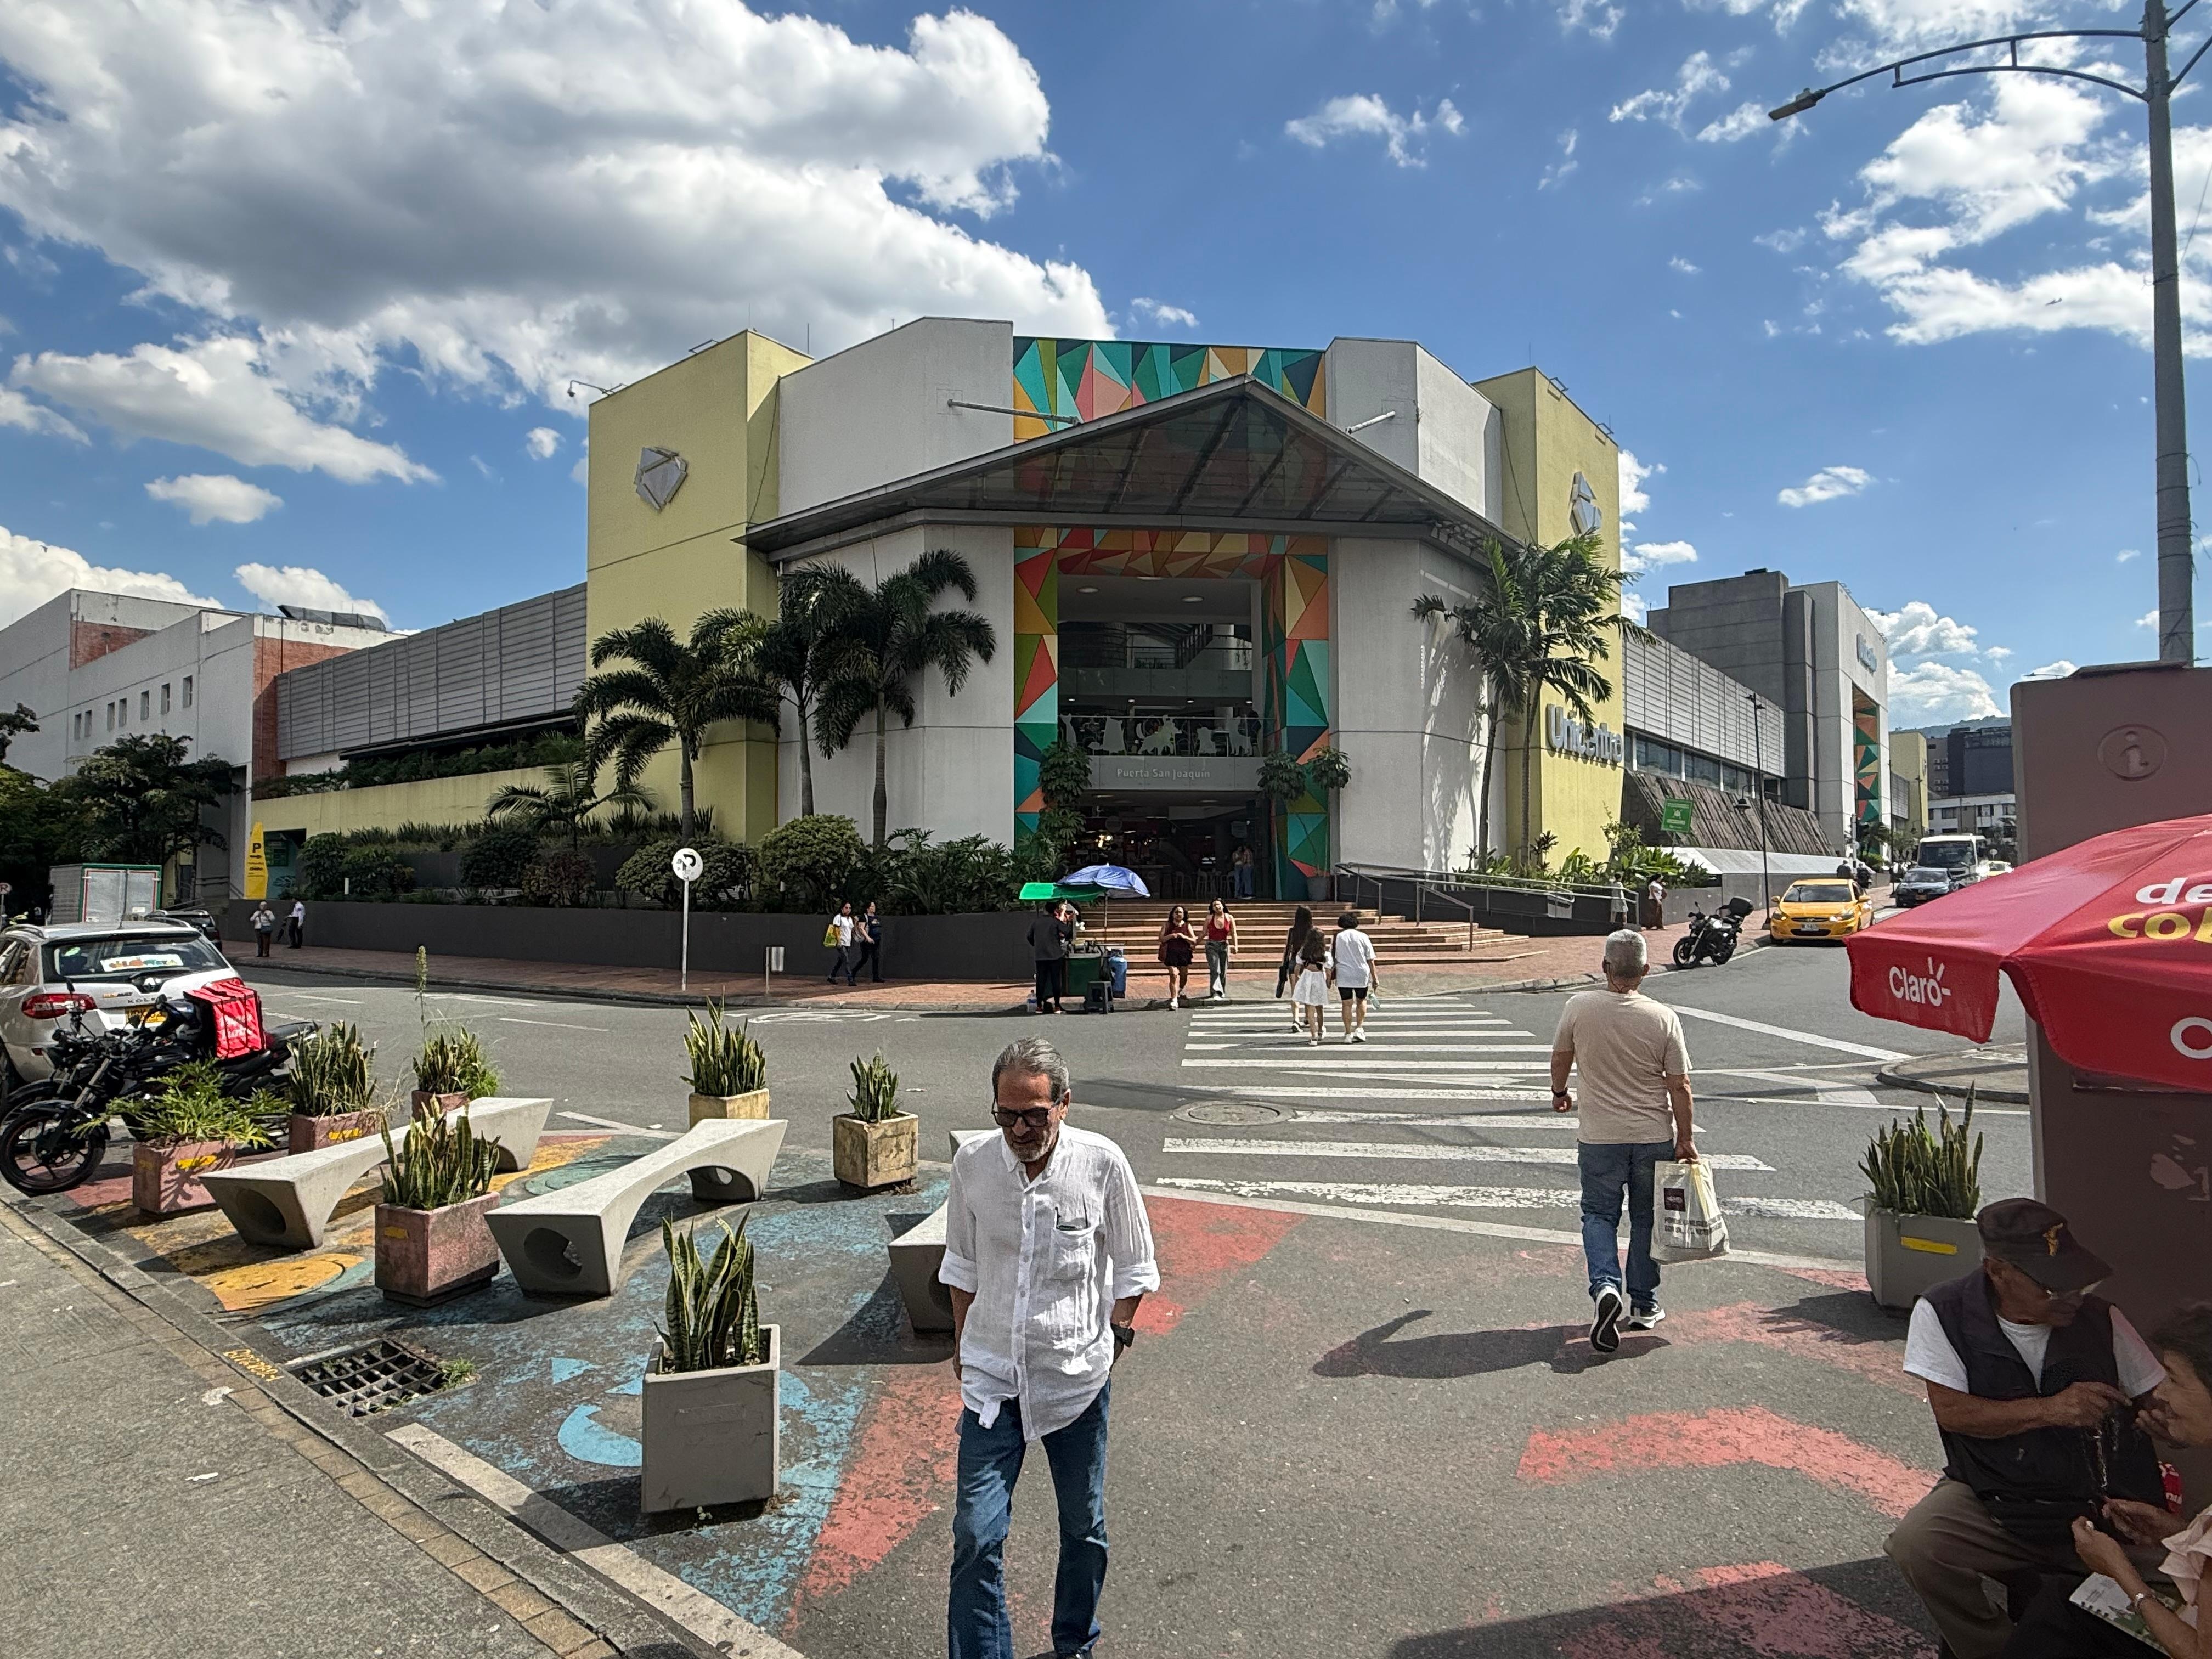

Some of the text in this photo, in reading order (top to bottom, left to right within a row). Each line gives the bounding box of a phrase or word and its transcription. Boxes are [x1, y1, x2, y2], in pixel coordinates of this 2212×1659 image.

[1545, 704, 1622, 763] Unicentro
[1116, 768, 1149, 778] Puerta
[1152, 768, 1170, 778] San
[252, 842, 262, 854] P
[1889, 961, 1946, 1006] Claro
